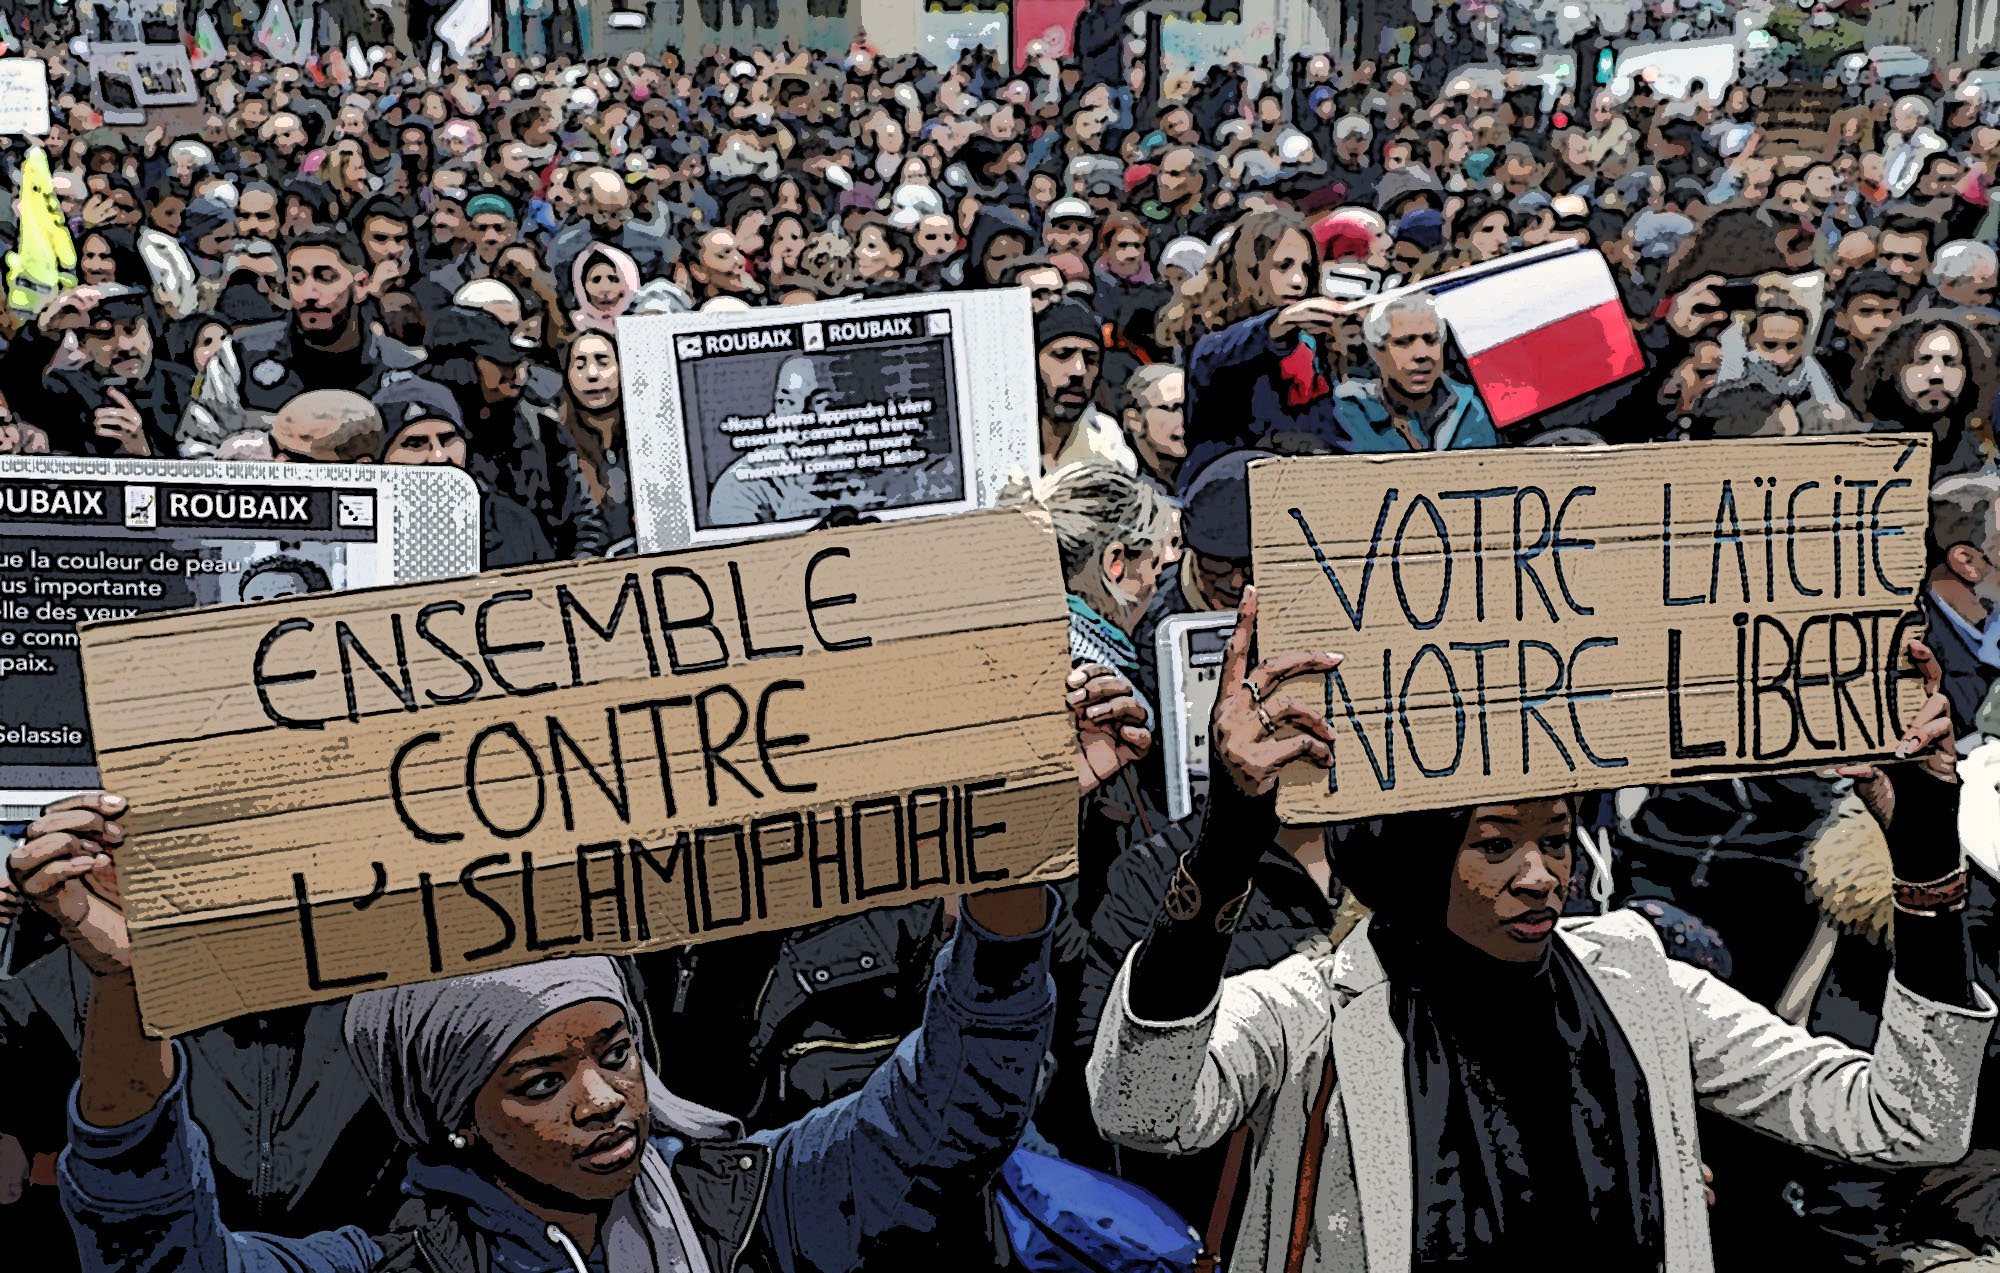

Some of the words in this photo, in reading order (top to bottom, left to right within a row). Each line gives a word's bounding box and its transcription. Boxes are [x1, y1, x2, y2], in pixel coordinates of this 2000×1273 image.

[705, 329, 793, 354] ROUBAIX
[828, 318, 913, 342] ROUBAIX
[169, 493, 309, 521] ROUBAIX
[30, 549, 50, 569] la
[56, 551, 143, 571] couleur
[150, 552, 179, 572] de
[185, 560, 241, 578] peau
[1287, 486, 1597, 632] VOTRE
[34, 575, 163, 601] importante
[0, 600, 29, 620] lle
[36, 601, 77, 620] des
[84, 606, 138, 622] yeux
[253, 546, 874, 731] ENSEMBLE
[0, 653, 55, 677] paix.
[1324, 636, 1628, 793] NOTRE
[388, 679, 819, 843] CONTRE
